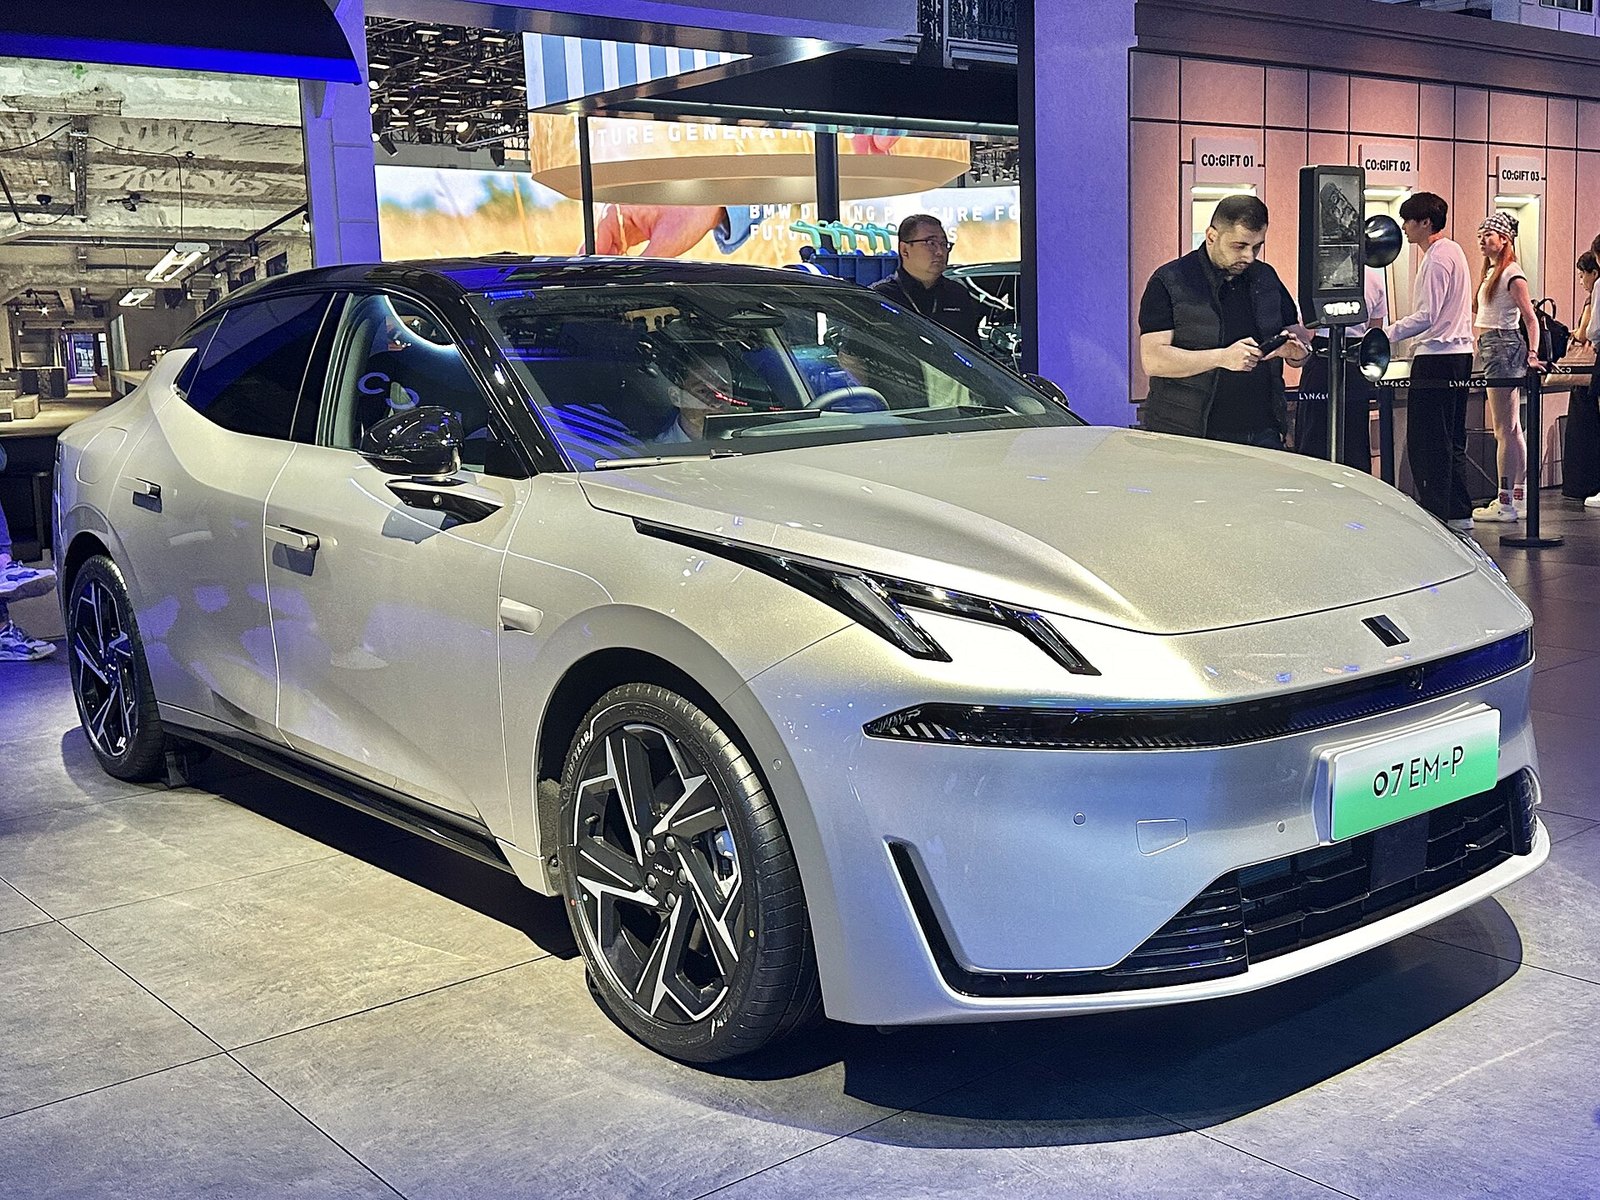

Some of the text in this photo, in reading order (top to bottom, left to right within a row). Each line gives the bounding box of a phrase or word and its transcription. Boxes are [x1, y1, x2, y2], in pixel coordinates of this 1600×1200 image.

[1201, 153, 1254, 167] CO:GIFT 01
[1365, 158, 1411, 172] CO:GIFT 02
[1501, 169, 1540, 182] CO:GIFT 03
[749, 203, 792, 219] BMW
[1372, 744, 1464, 797] 07 EM-P
